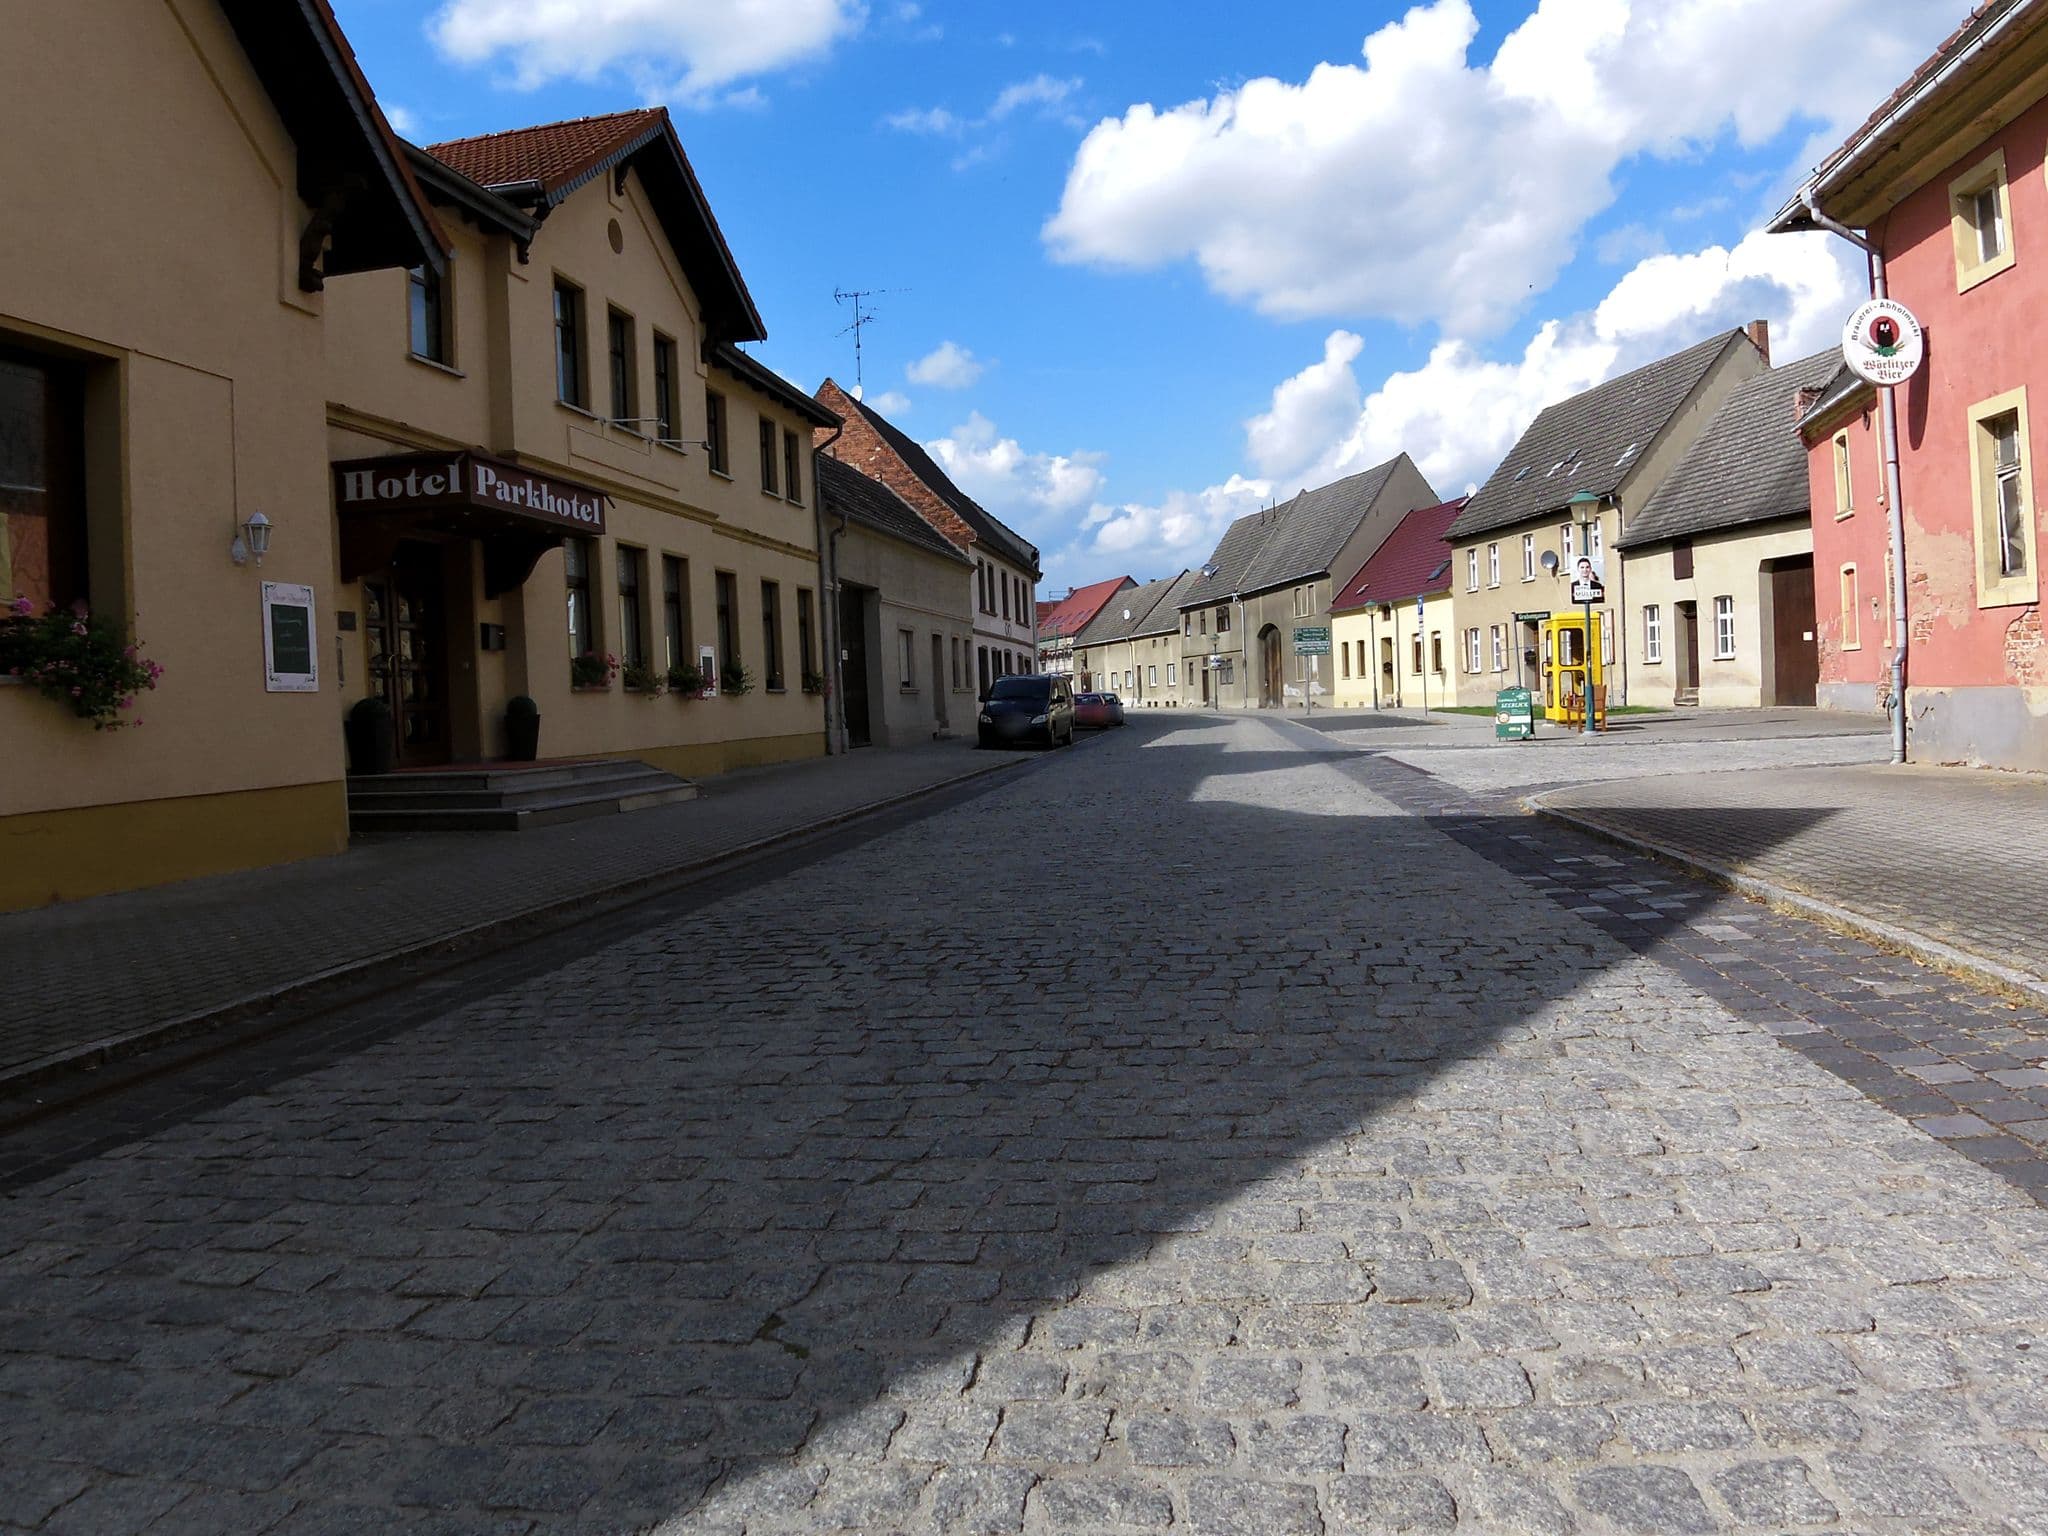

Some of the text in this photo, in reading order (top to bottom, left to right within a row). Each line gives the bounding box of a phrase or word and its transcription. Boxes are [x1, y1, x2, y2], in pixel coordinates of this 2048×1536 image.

[1852, 306, 1873, 341] Brauerei
[1880, 302, 1921, 338] Abholmarkt
[1863, 359, 1915, 370] Wörlitzer
[1877, 370, 1903, 380] Bier
[343, 463, 462, 503] Hotel
[475, 464, 601, 525] Parkhotel
